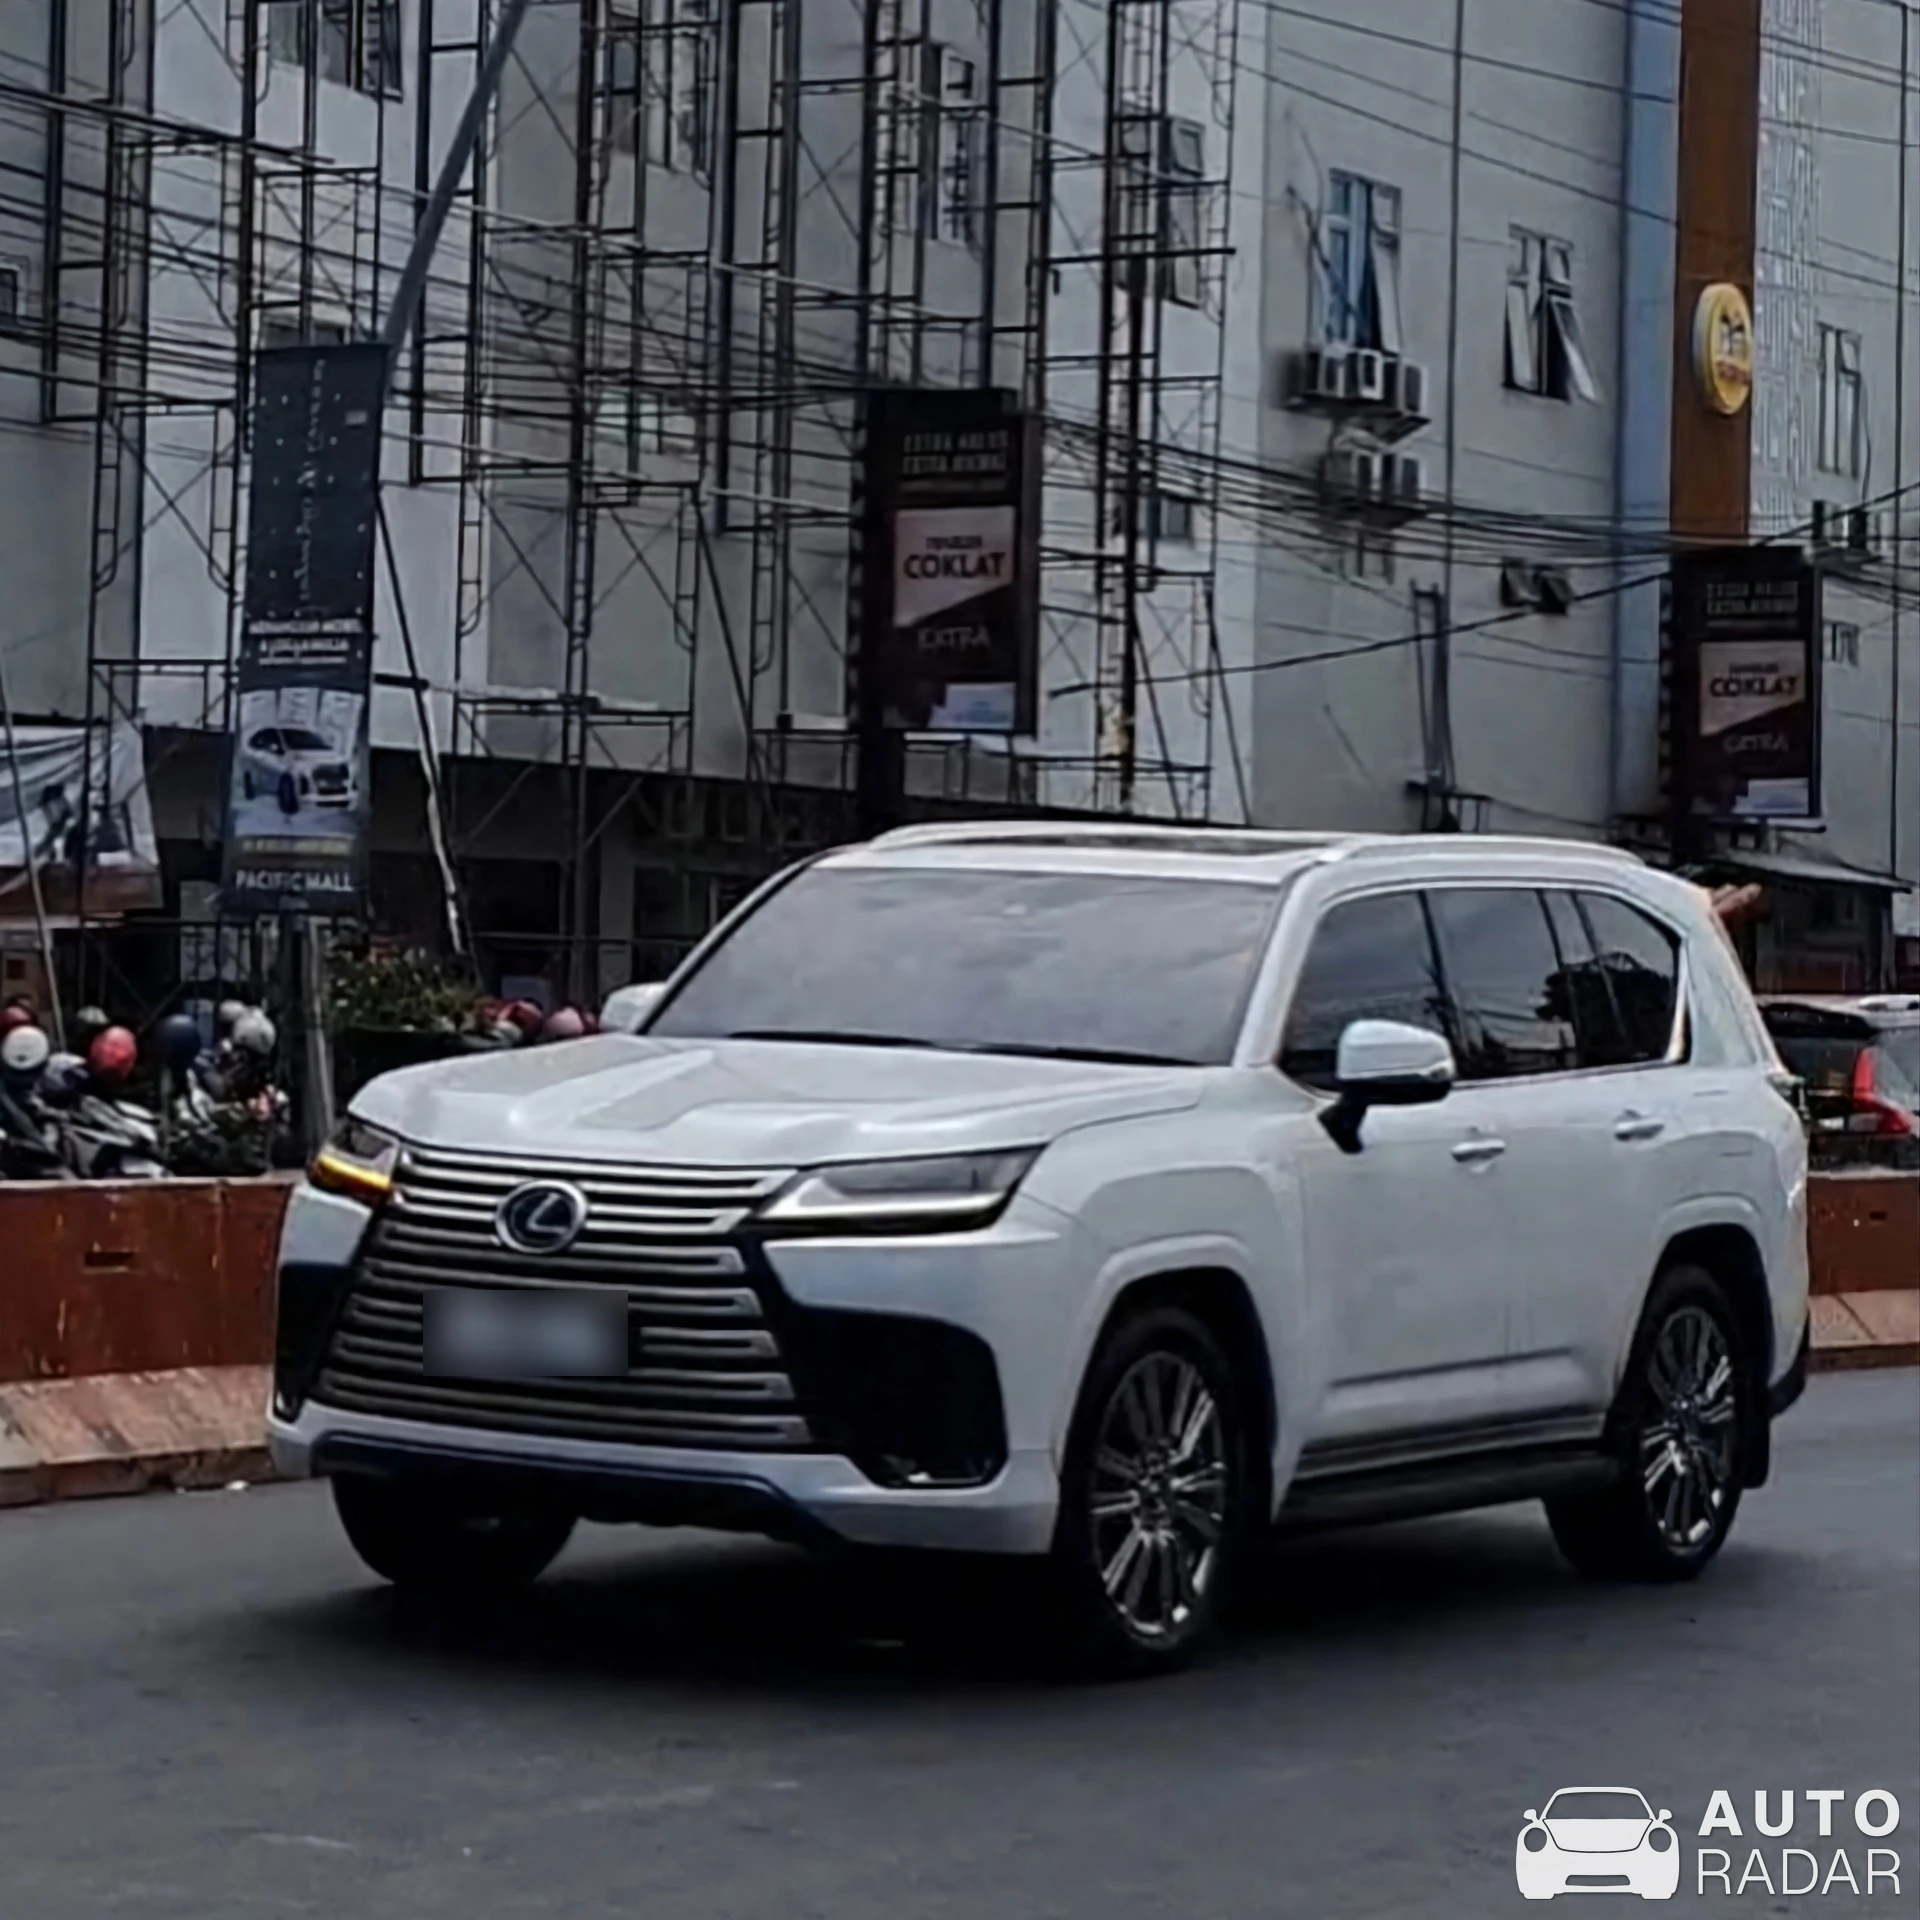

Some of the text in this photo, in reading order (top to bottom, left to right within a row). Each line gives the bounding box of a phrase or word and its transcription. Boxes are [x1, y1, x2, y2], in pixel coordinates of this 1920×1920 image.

[904, 553, 1004, 578] COKLAT
[917, 624, 991, 651] EXTRA
[1711, 676, 1796, 697] COKLAT
[236, 870, 353, 892] PACIFIC MALL
